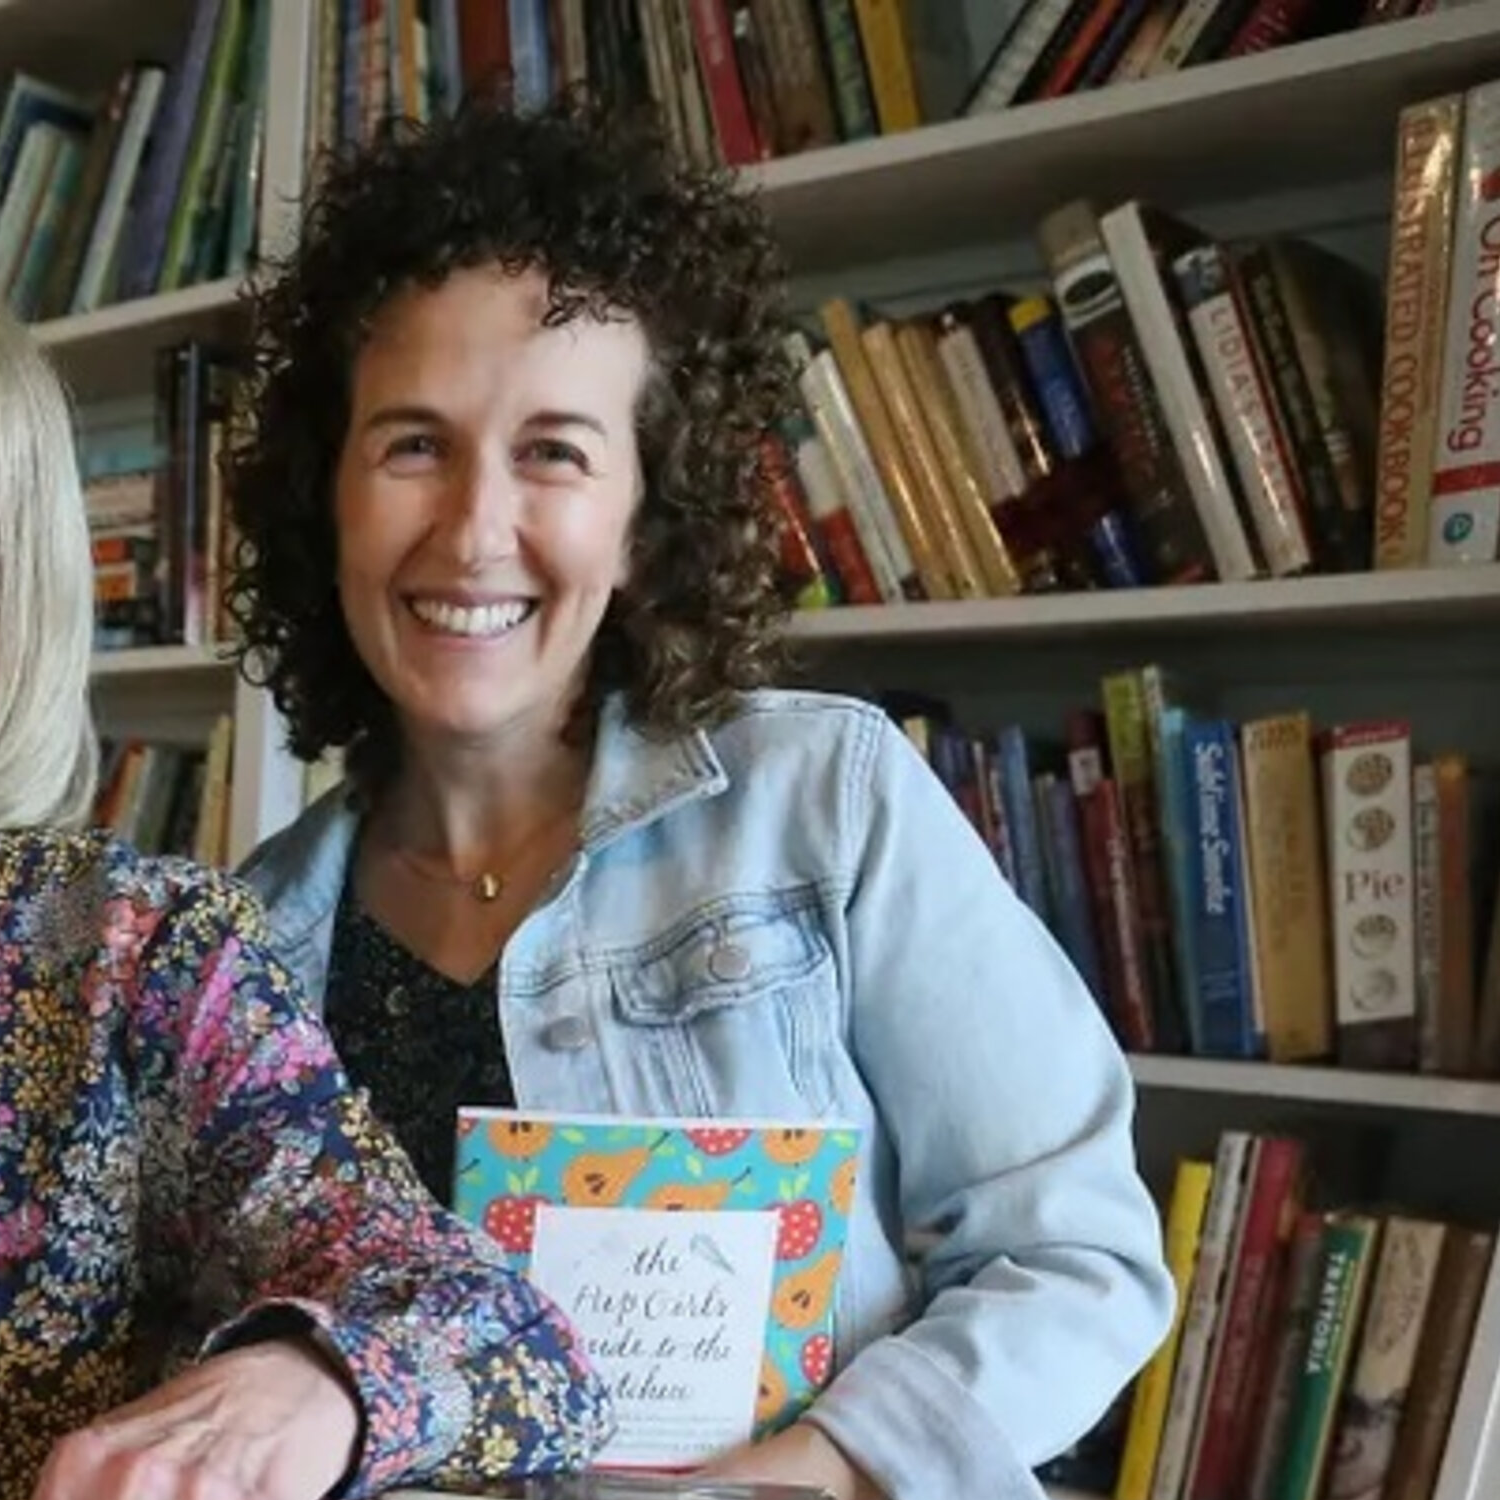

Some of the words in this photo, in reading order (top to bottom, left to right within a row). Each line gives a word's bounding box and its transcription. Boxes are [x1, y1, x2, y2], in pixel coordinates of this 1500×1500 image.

[1380, 355, 1418, 542] COOKBOOK
[1345, 868, 1404, 904] Pie
[626, 1237, 682, 1276] the
[1306, 1252, 1348, 1374] TRATTORIA
[587, 1327, 642, 1358] uide
